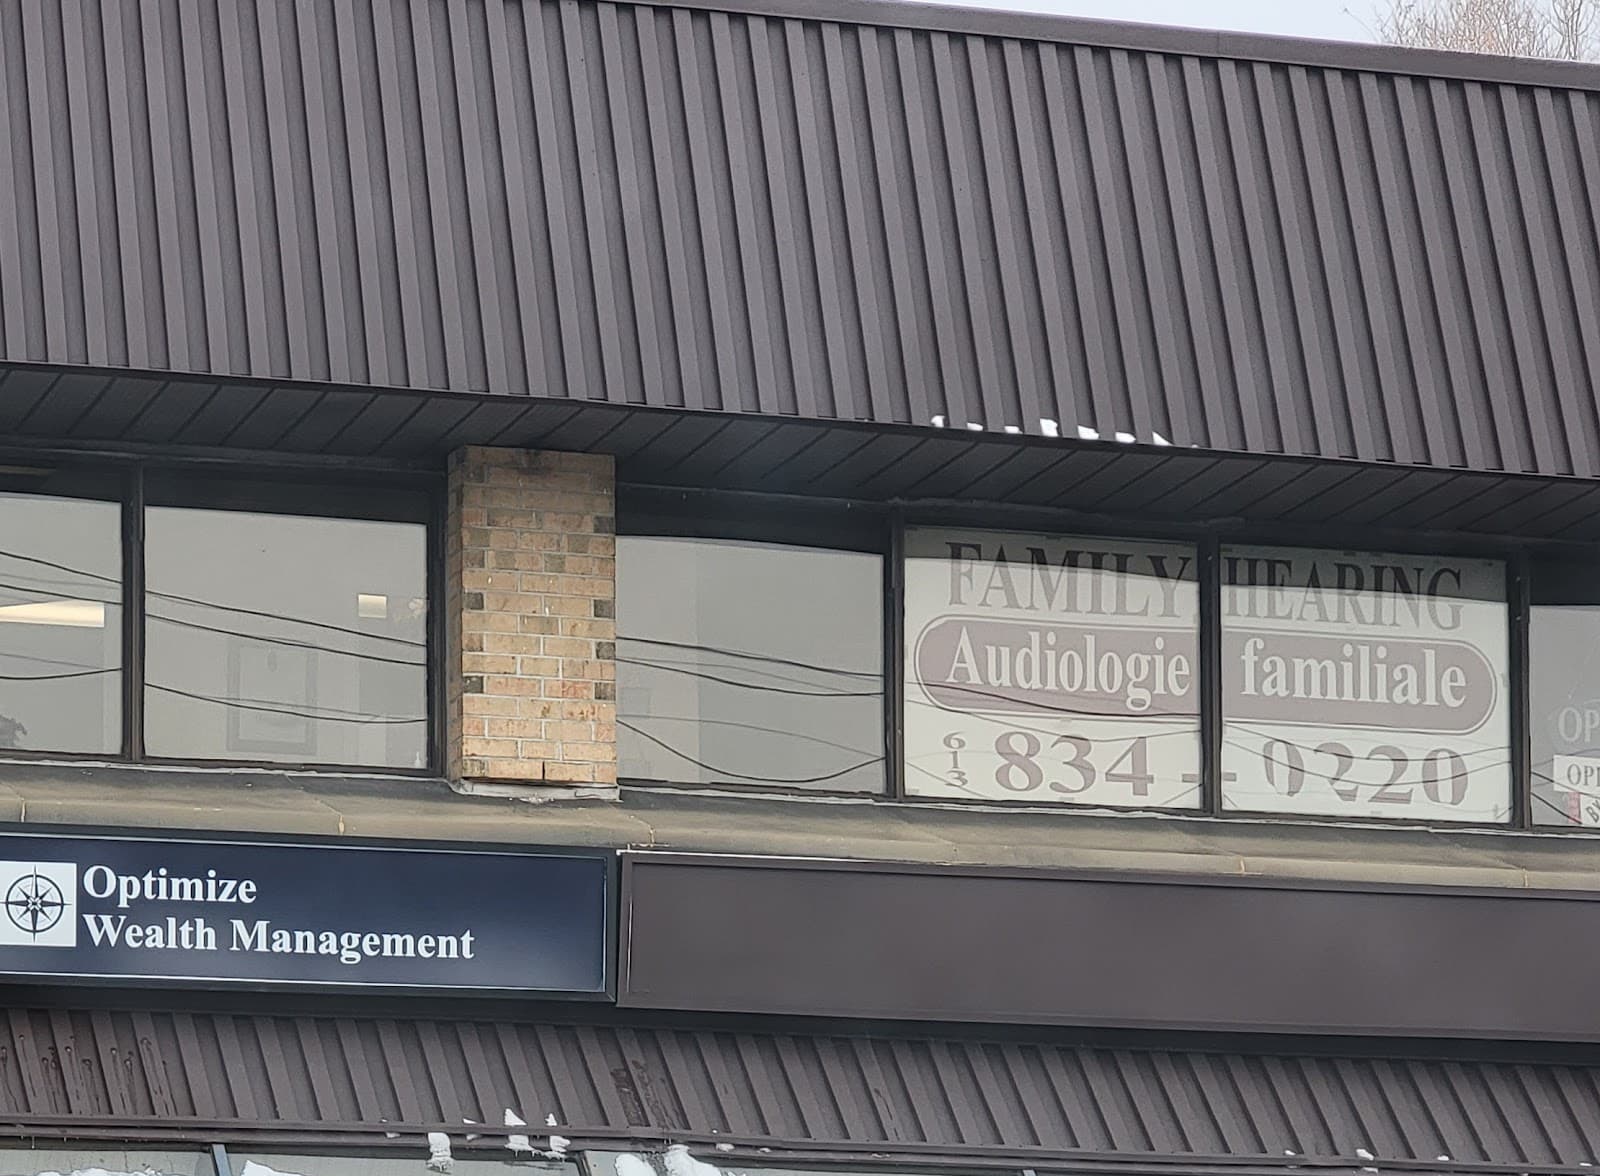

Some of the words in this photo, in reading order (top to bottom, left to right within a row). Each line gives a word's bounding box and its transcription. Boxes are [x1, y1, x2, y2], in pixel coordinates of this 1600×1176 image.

[945, 541, 1192, 618] FAMILY
[1223, 557, 1462, 630] HEARING
[945, 626, 1191, 710] Audiologie
[1240, 638, 1467, 707] familiale
[1262, 739, 1468, 806] 0220
[82, 865, 257, 908] Optimize
[82, 914, 217, 952] Wealth
[230, 919, 475, 965] Management
